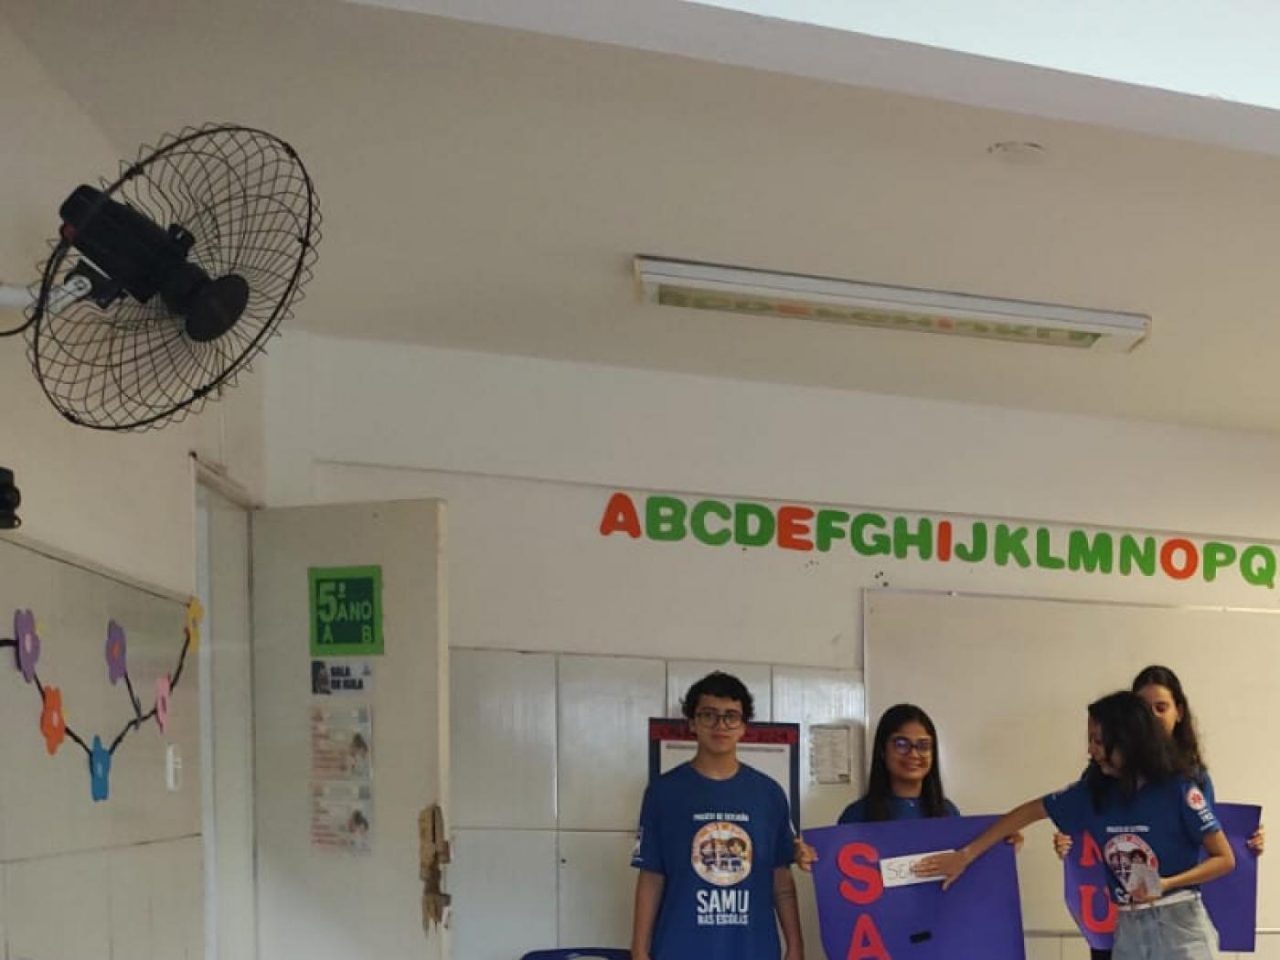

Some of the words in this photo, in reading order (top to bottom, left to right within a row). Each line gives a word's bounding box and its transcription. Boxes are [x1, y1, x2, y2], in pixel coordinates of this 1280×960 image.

[336, 601, 373, 621] ANO
[323, 623, 334, 643] A
[837, 842, 884, 905] S
[696, 889, 749, 913] SAMU
